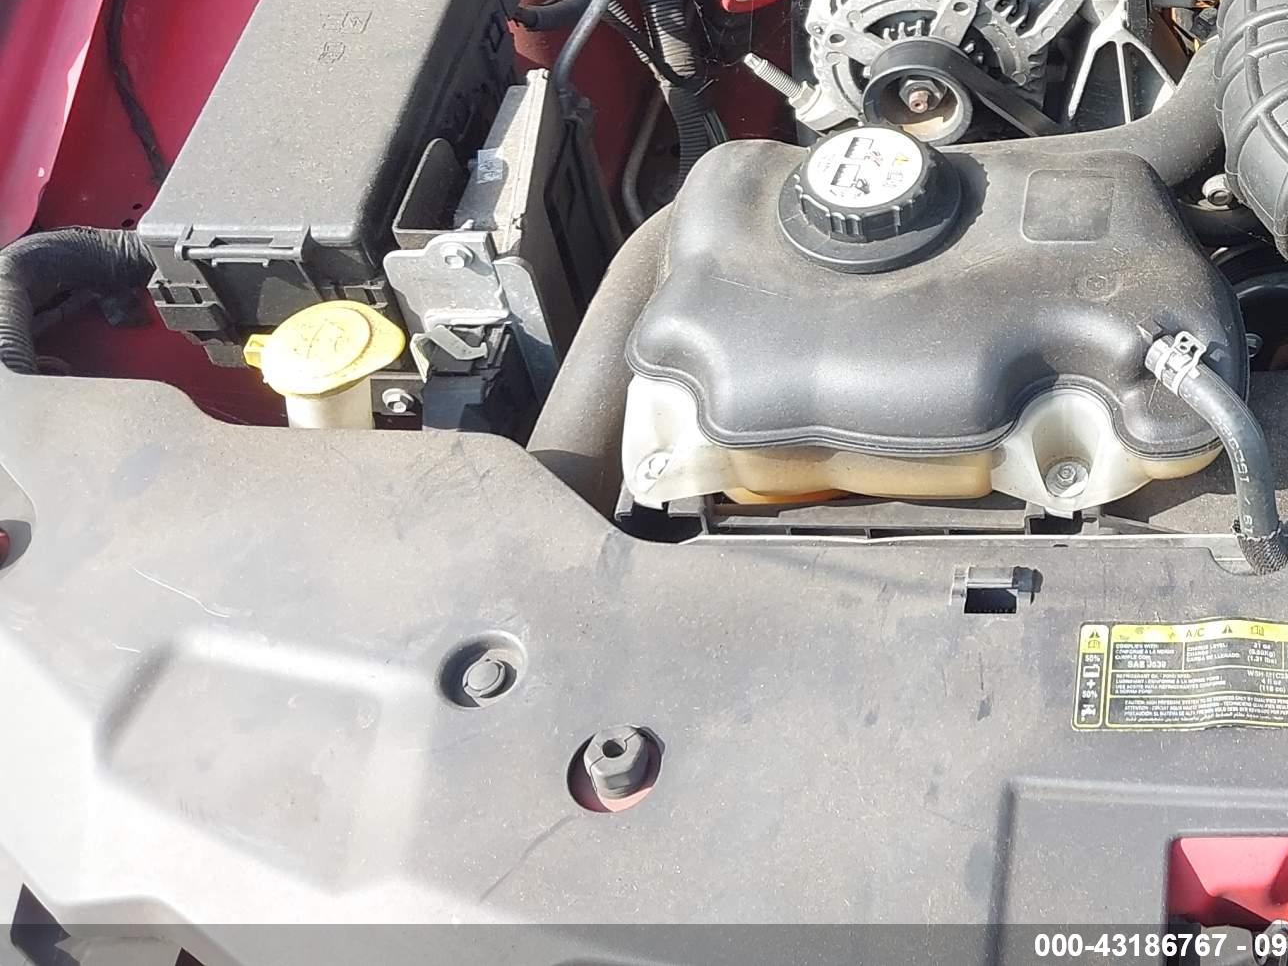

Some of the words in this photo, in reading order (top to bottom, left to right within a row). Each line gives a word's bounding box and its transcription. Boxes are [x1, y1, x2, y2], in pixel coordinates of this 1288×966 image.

[1186, 627, 1205, 638] A/C
[1085, 654, 1100, 663] 50%
[1082, 689, 1097, 698] 50%
